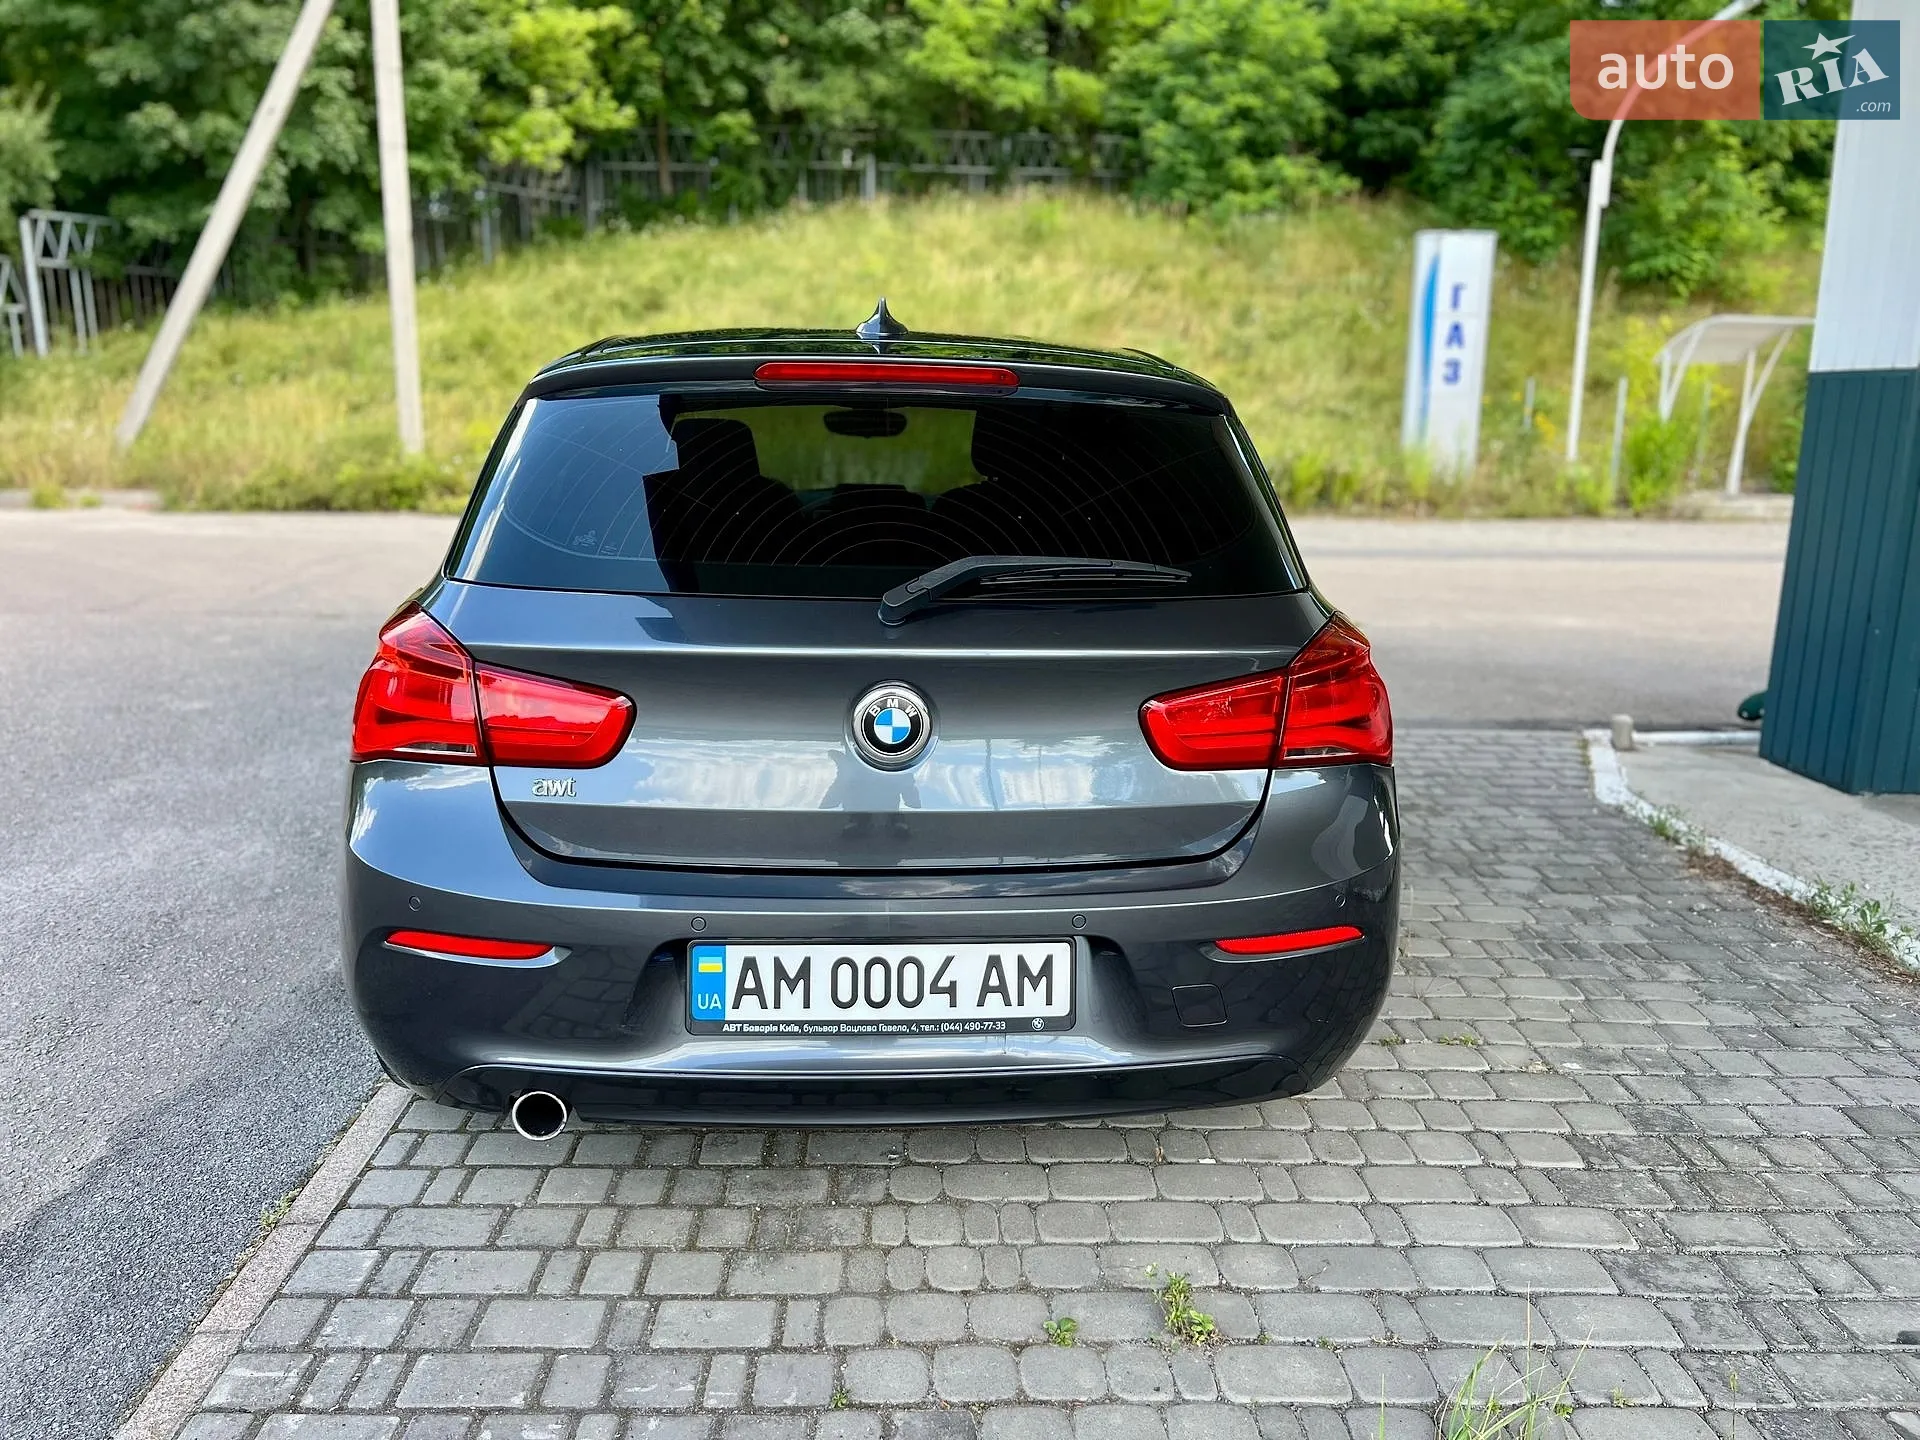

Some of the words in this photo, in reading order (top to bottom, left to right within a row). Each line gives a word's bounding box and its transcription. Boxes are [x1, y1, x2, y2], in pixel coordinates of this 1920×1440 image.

[1442, 282, 1466, 386] ГАЗ
[868, 698, 918, 718] BMW
[531, 777, 577, 797] awt
[731, 955, 811, 1010] AM
[830, 955, 958, 1009] 0004
[976, 954, 1054, 1008] AM
[697, 993, 722, 1010] UA
[780, 1023, 802, 1034] Київ,
[803, 1023, 838, 1034] бульвар
[840, 1023, 877, 1034] Вацлава
[911, 1023, 919, 1033] 4,
[940, 1022, 963, 1033] (044)
[964, 1021, 1006, 1031] 490-77-33
